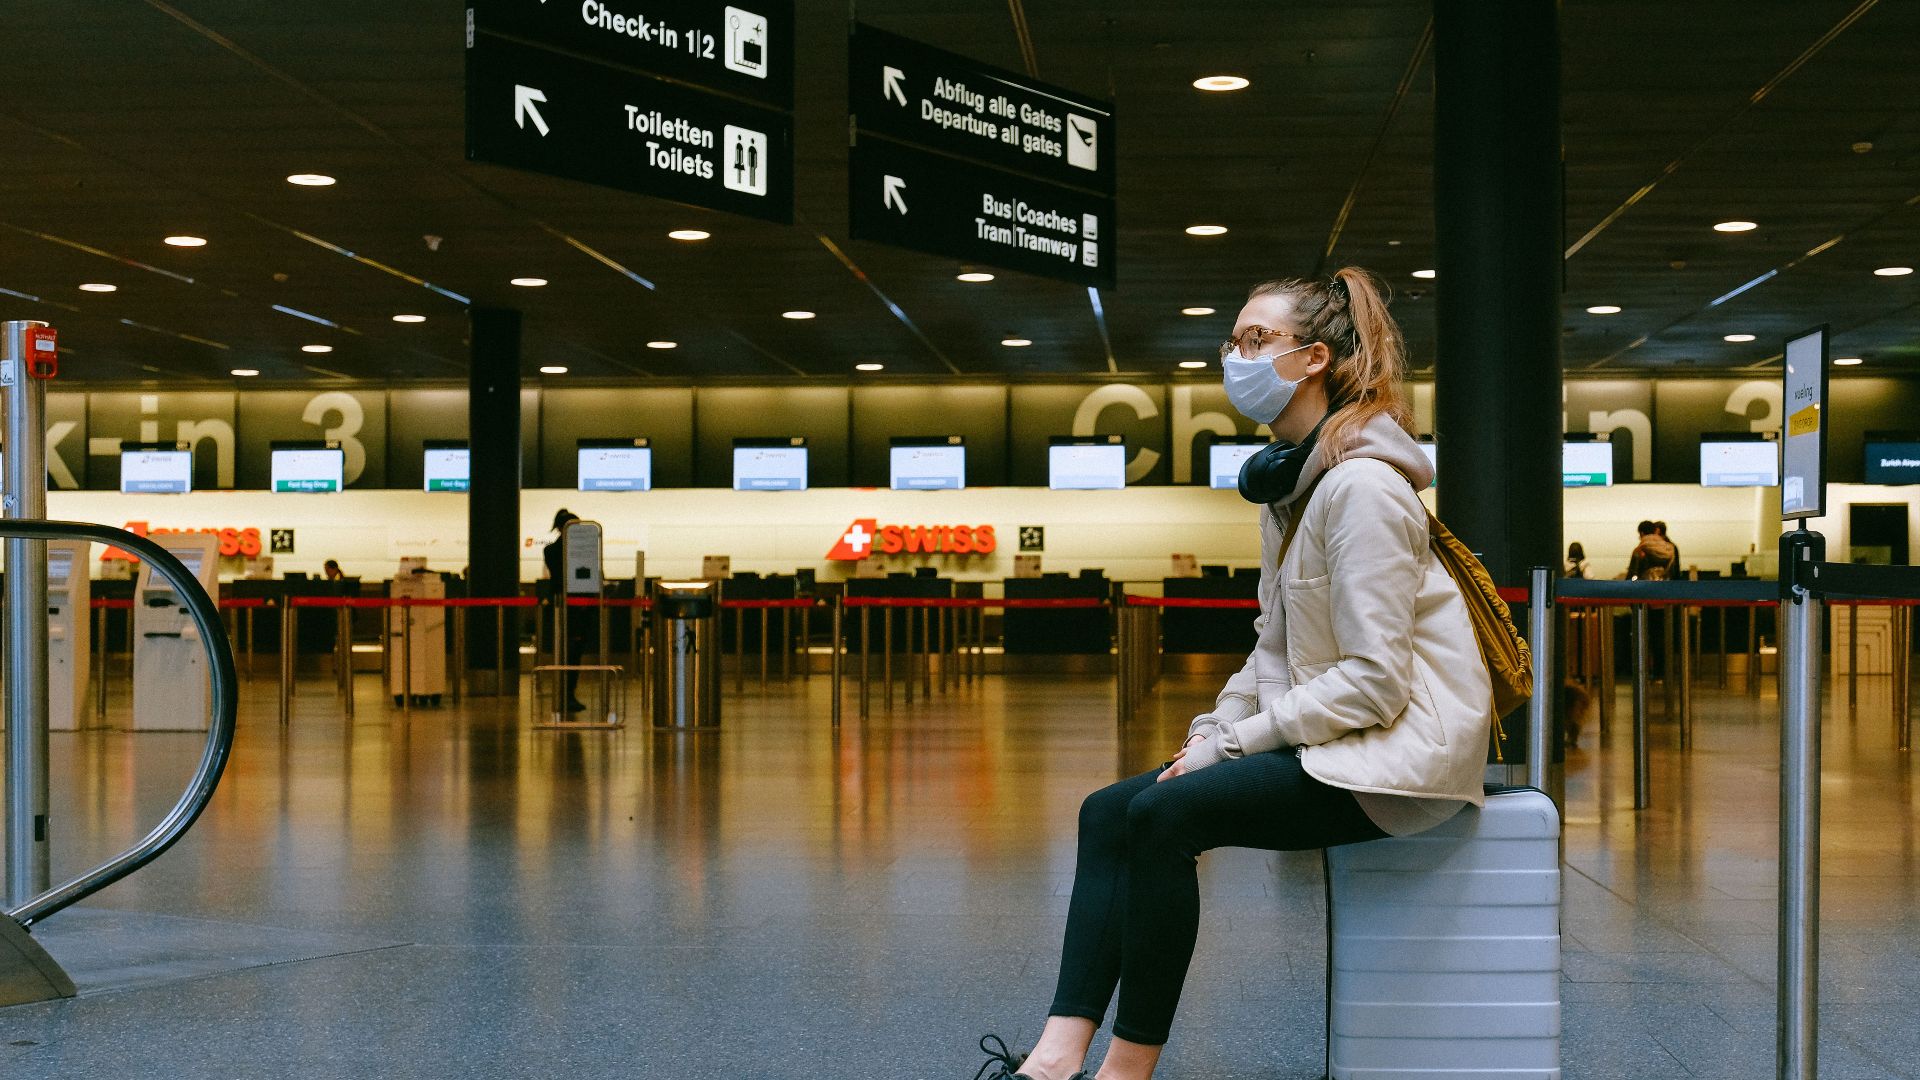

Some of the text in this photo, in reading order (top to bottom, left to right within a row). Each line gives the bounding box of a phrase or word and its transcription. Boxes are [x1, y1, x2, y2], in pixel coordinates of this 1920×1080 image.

[582, 0, 678, 49] Check-in
[624, 104, 714, 149] Toiletten
[921, 98, 1062, 157] Departure all gates
[933, 76, 1062, 133] Abflug alle Gates
[646, 141, 714, 179] Toilets
[301, 390, 366, 486] 3
[880, 524, 997, 554] SWISS
